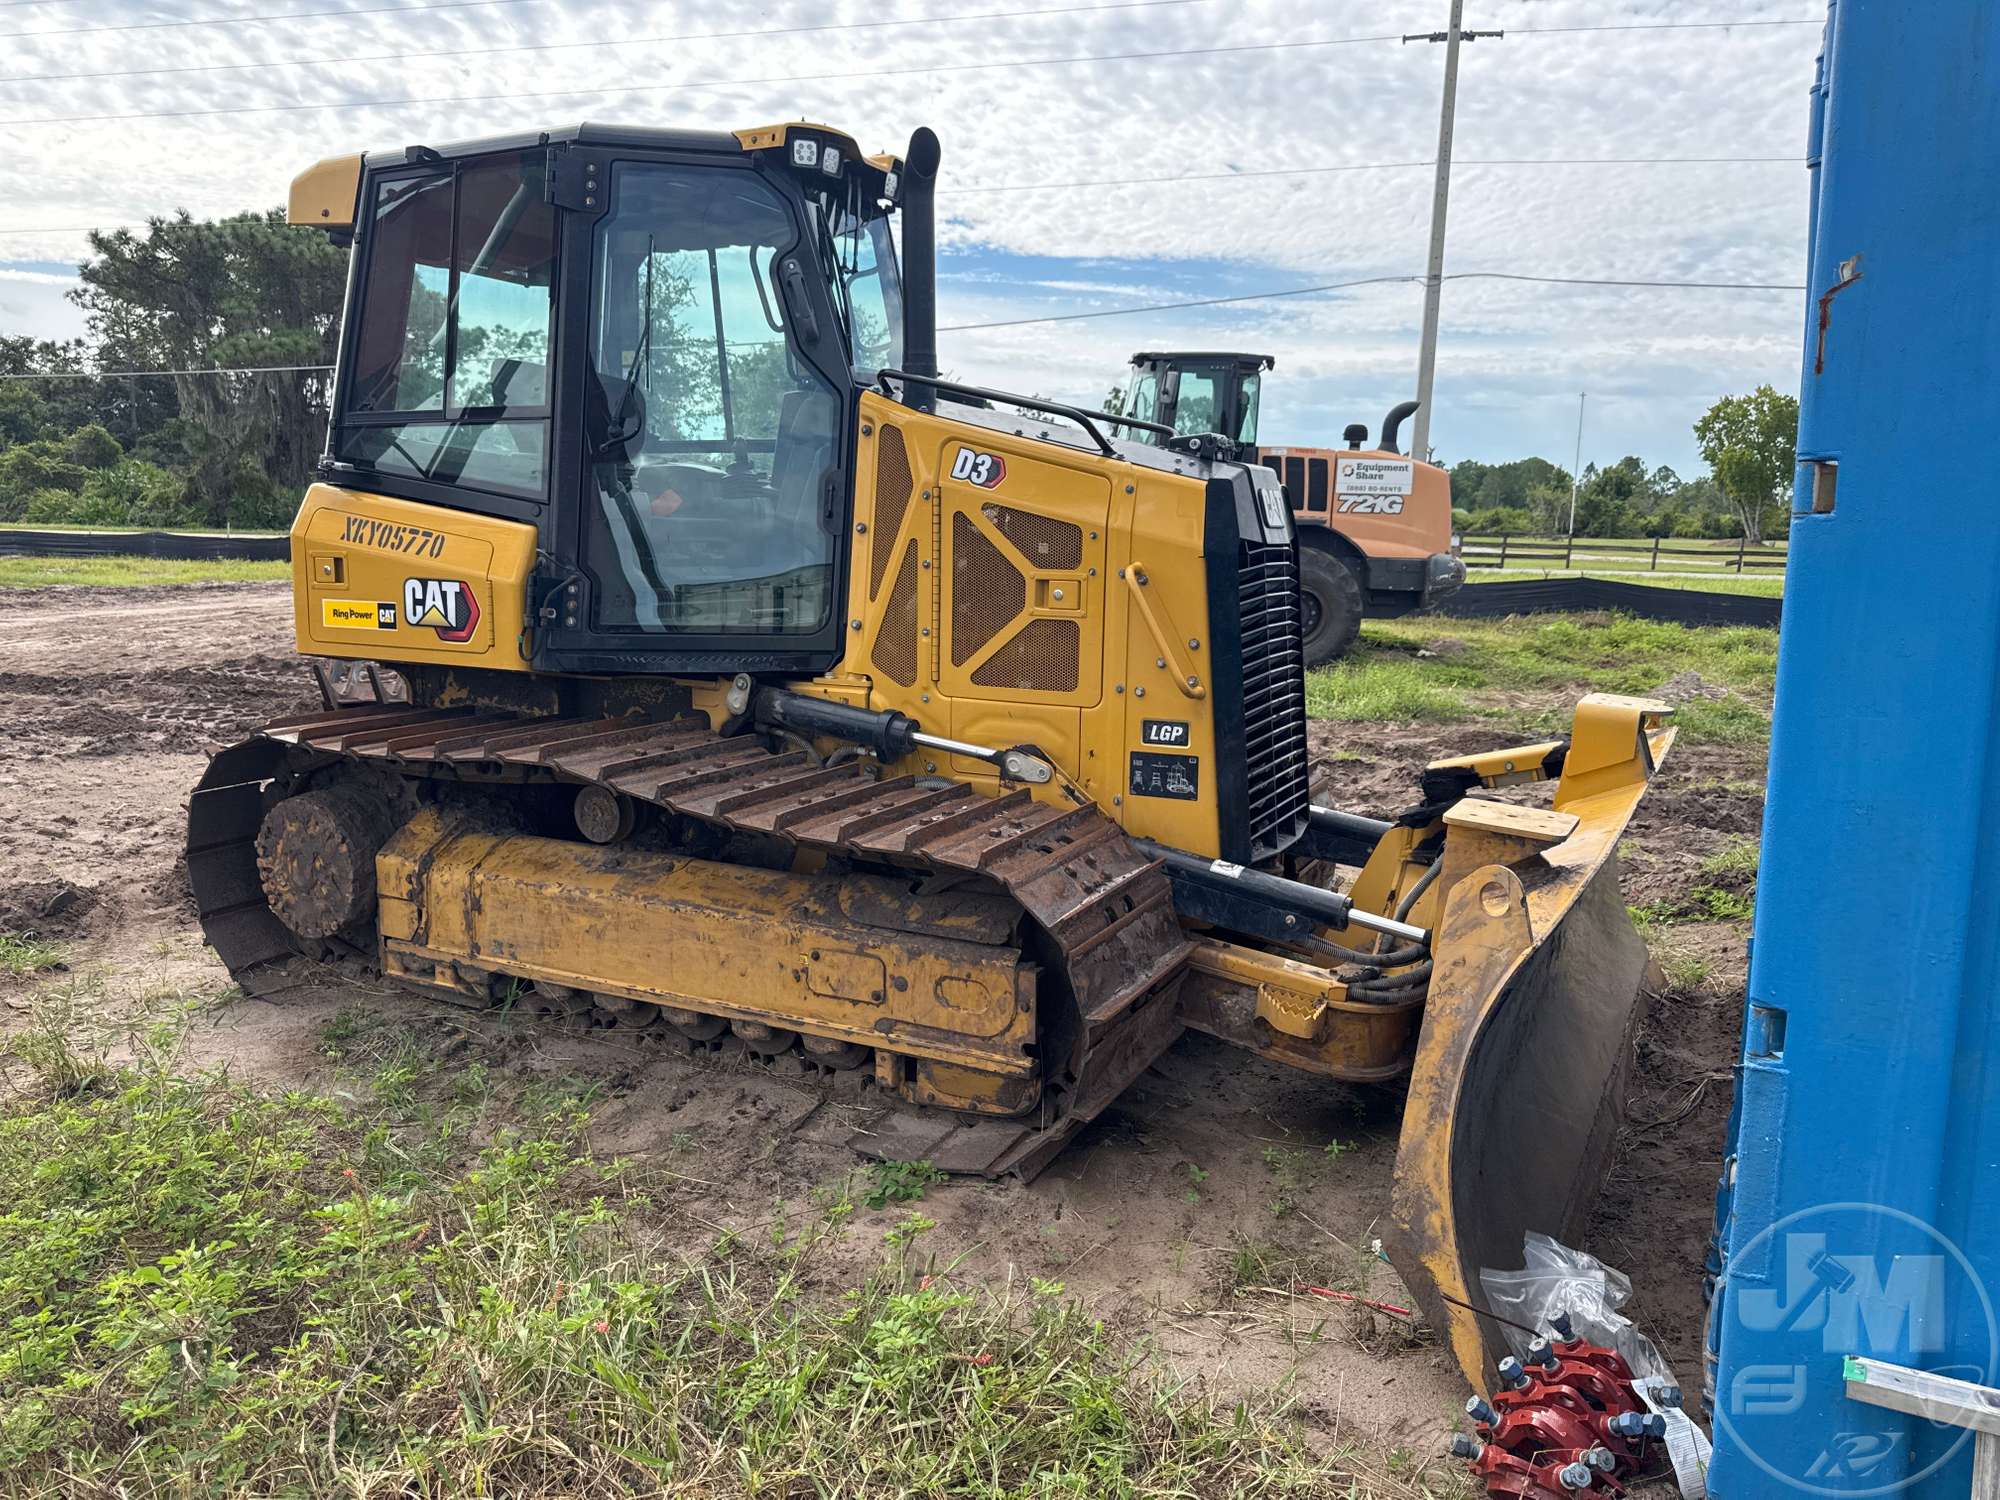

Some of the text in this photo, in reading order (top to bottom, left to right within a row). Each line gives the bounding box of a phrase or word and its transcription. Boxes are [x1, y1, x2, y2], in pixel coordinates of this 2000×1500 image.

[952, 447, 992, 484] D3
[1356, 463, 1408, 472] Equipment
[1356, 472, 1384, 480] Share
[1338, 494, 1404, 514] 721G
[340, 516, 445, 559] XKY05770
[404, 578, 461, 628] CAT
[379, 609, 395, 623] CAT
[1150, 725, 1183, 741] LGP
